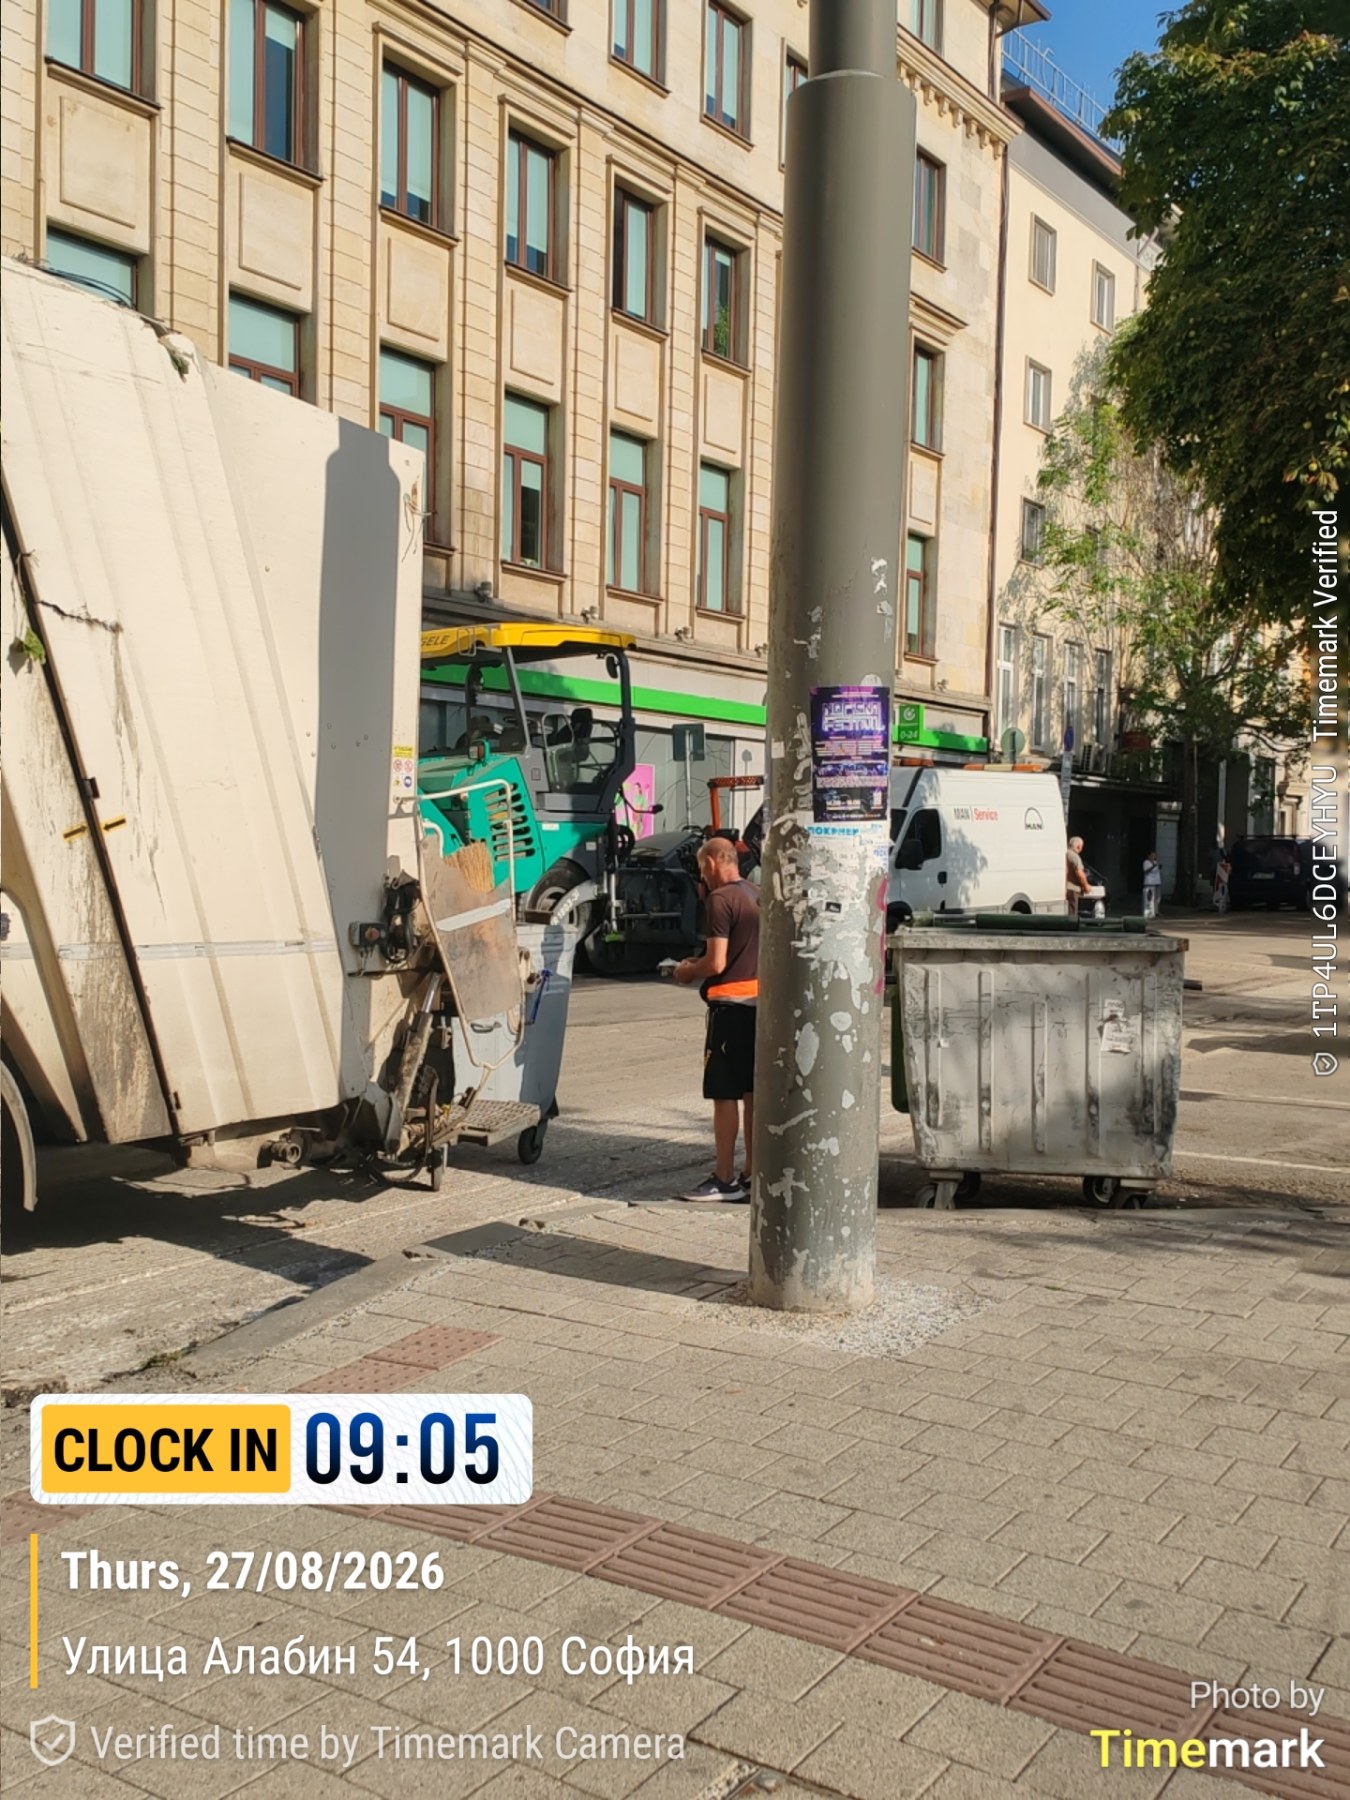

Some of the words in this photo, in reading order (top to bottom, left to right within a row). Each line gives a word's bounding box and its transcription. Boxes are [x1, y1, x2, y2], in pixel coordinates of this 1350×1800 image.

[900, 730, 918, 739] 0-24
[953, 808, 970, 820] MAN
[973, 808, 999, 821] Service
[1025, 823, 1043, 831] MAN
